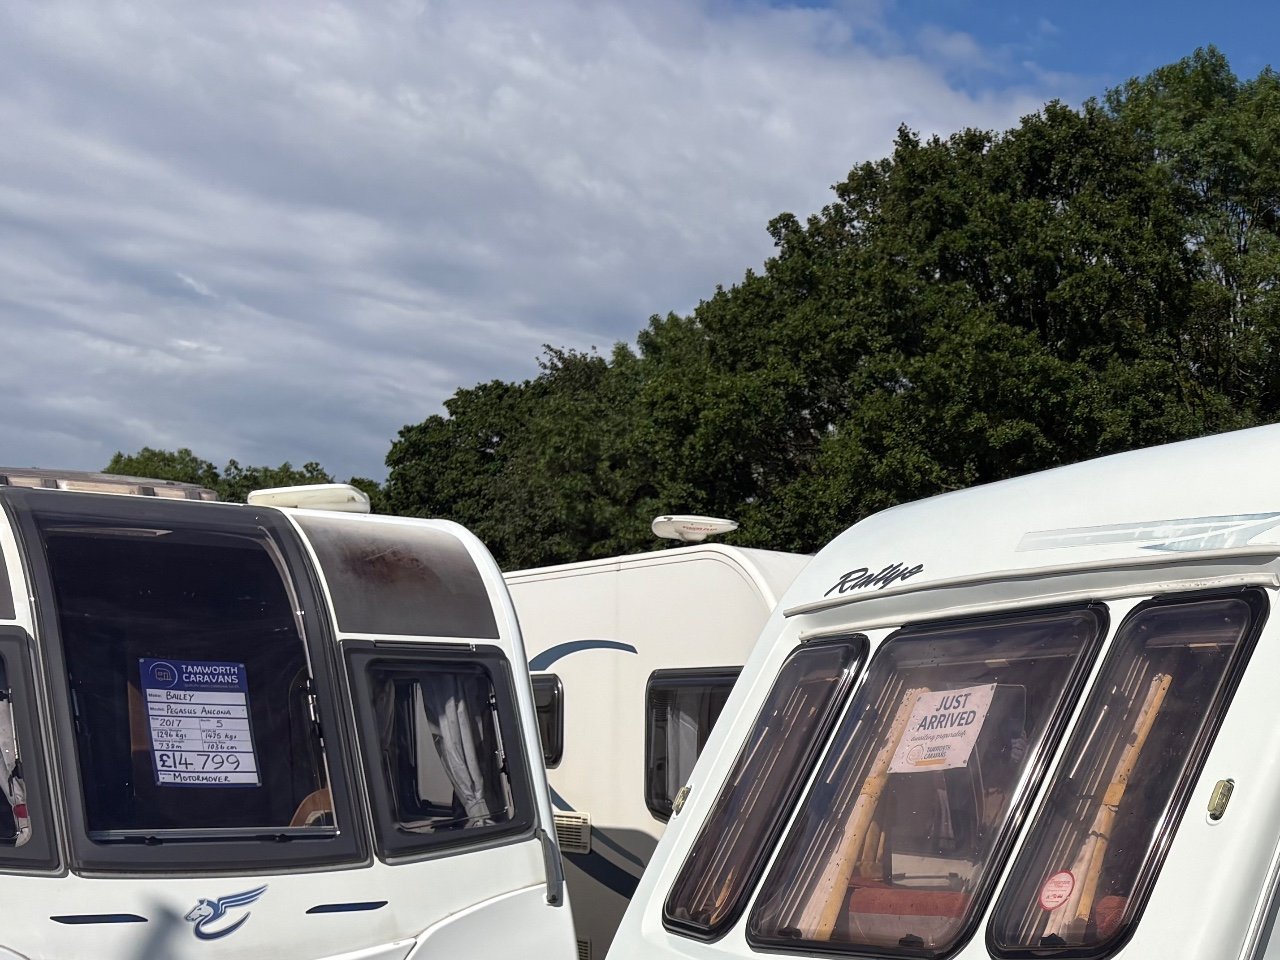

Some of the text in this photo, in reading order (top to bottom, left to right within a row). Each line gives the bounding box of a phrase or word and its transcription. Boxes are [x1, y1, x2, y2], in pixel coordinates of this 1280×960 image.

[823, 562, 924, 597] Rallye
[182, 665, 238, 674] TAMWORTH
[183, 674, 239, 683] CARAVANS
[166, 691, 194, 702] BAILEY
[936, 693, 972, 712] JUST
[166, 705, 197, 715] PEGASUS
[200, 706, 231, 716] ANCONA
[159, 718, 182, 728] 2017
[216, 720, 224, 728] 5
[917, 710, 977, 731] ARRIVED
[173, 773, 231, 783] MOTORMOVER
